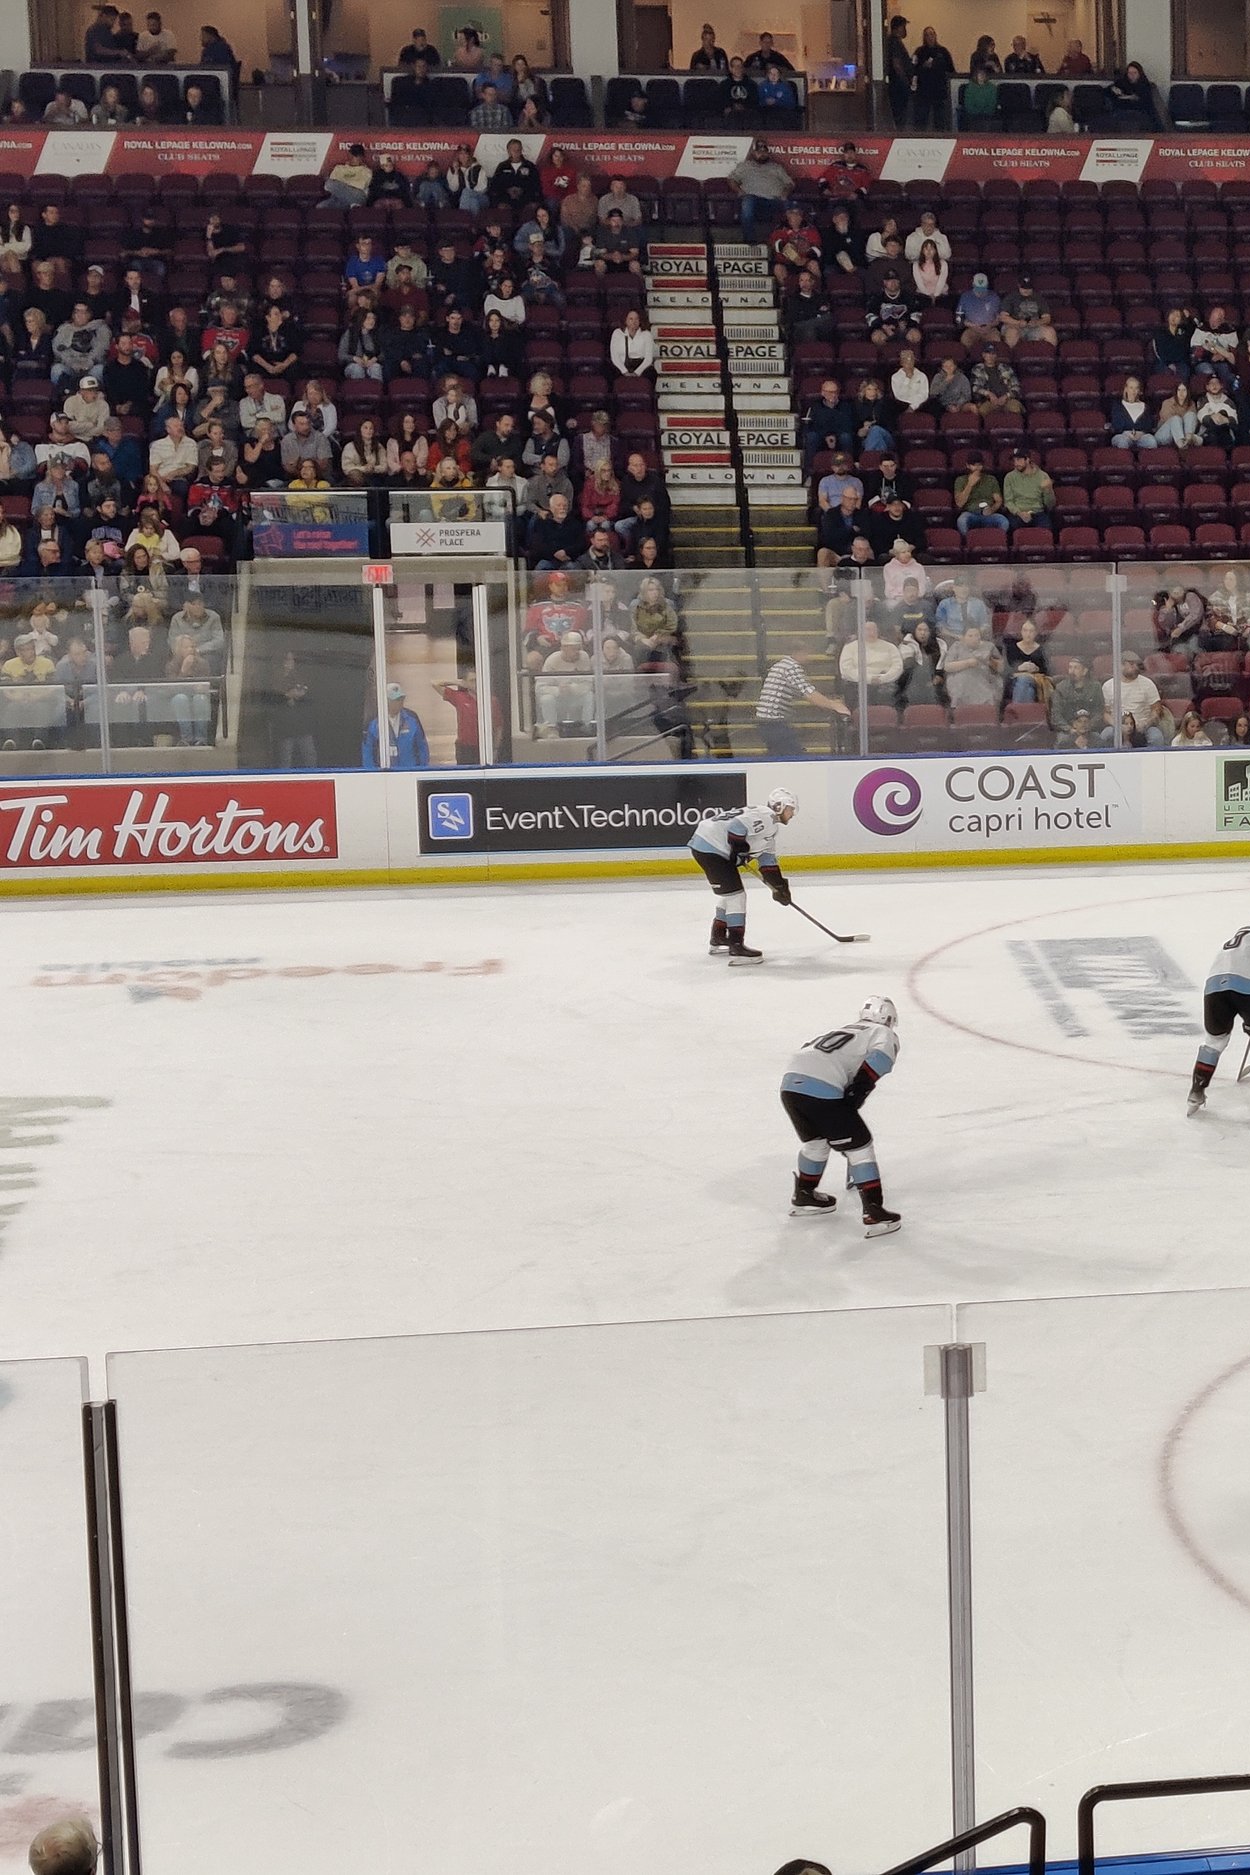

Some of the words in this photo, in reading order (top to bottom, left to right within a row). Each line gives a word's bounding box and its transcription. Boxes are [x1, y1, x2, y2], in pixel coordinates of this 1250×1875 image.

[124, 140, 152, 150] ROYAL
[155, 140, 190, 150] LEPAGE
[370, 142, 404, 150] LEPAGE
[583, 142, 616, 151] LEPAGE
[788, 146, 820, 155] LEPAGE
[962, 148, 989, 156] ROYAL
[991, 148, 1023, 156] LEPAGE
[1158, 148, 1185, 157] ROYAL
[1187, 149, 1220, 157] LEPAGE
[158, 153, 184, 161] CLUB
[187, 154, 220, 162] SEATS
[790, 158, 814, 166] CLUB
[993, 160, 1018, 168] CLUB
[1189, 160, 1214, 168] CLUB
[650, 262, 704, 274] ROYAL
[716, 262, 763, 274] EPAGE
[659, 345, 717, 356] ROYAL
[727, 346, 778, 357] EPAGE
[668, 432, 726, 445] ROYAL
[738, 433, 790, 445] EPAGE
[439, 538, 464, 546] PLACE
[945, 763, 1106, 802] COAST
[949, 807, 1022, 838] capri
[1034, 804, 1112, 830] hotel
[0, 795, 102, 862] Tim
[113, 790, 324, 858] Hortons
